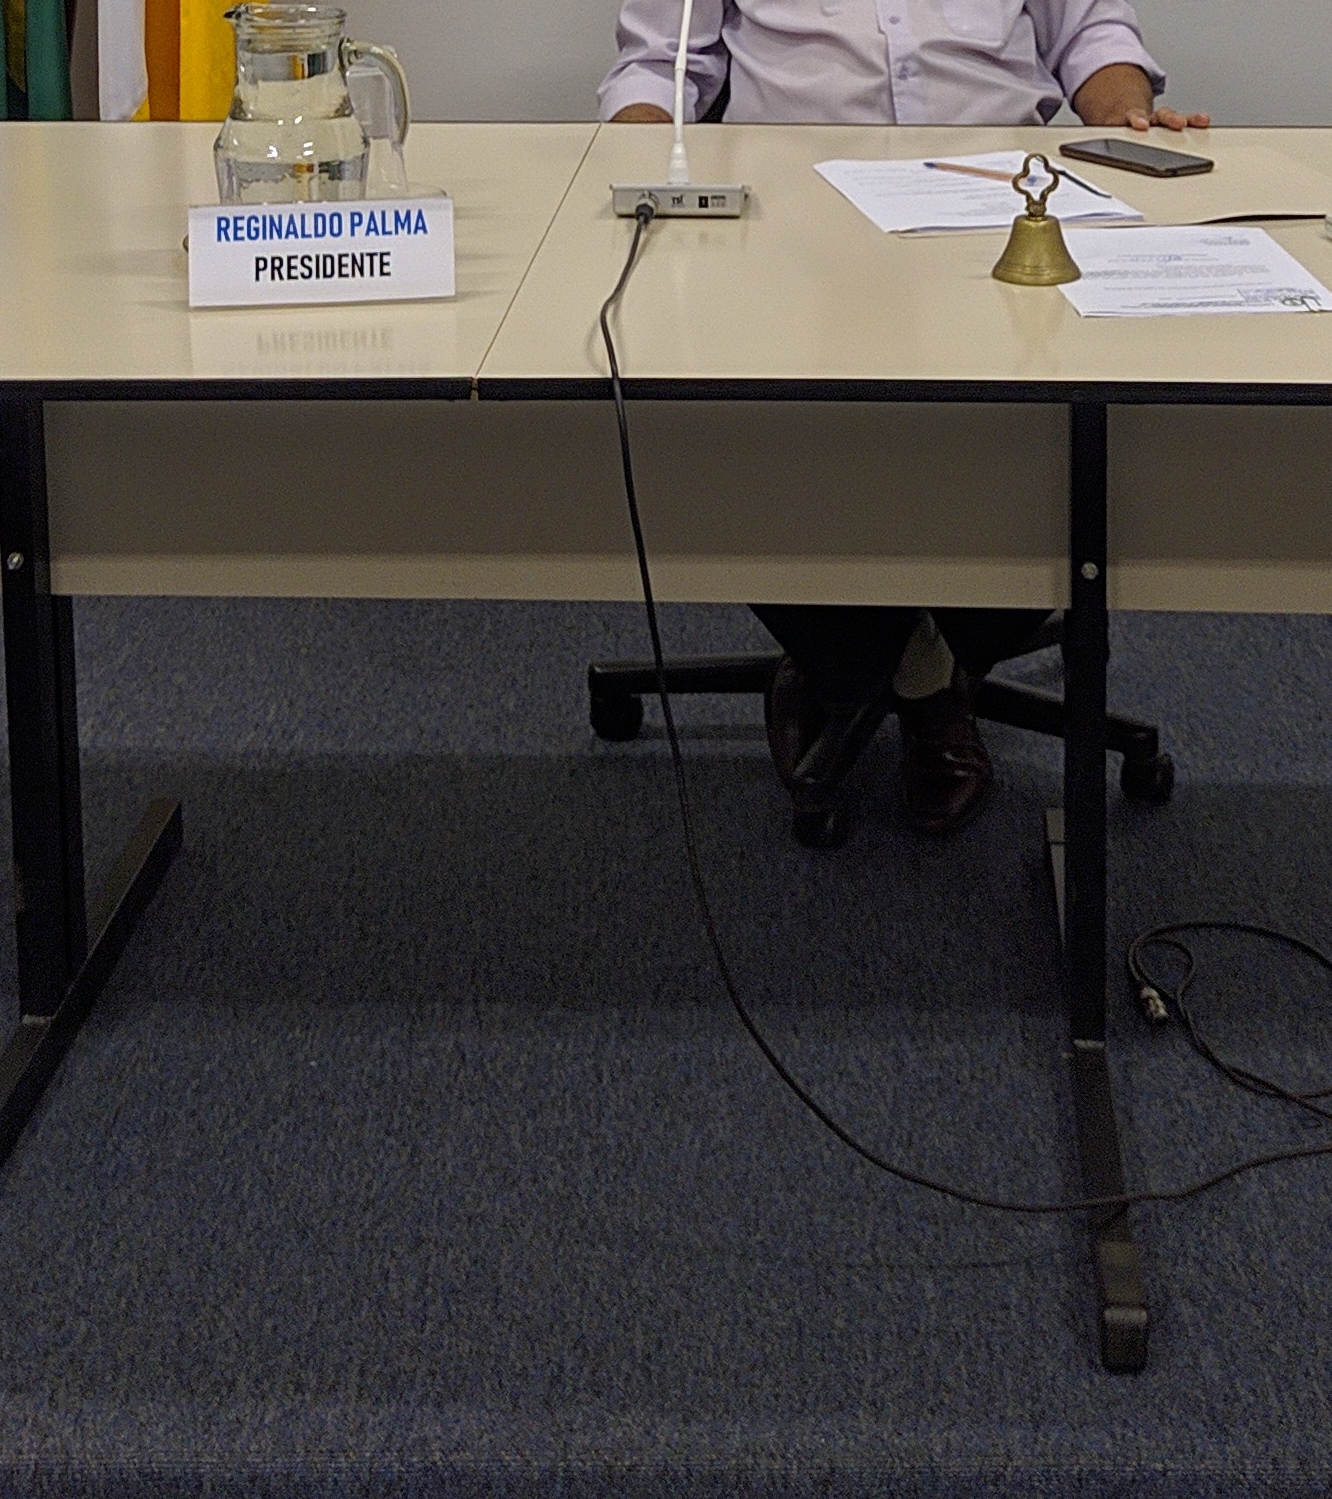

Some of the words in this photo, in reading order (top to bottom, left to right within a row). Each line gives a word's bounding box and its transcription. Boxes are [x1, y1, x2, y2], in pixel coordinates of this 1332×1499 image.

[216, 212, 344, 243] REGINALDO
[350, 208, 429, 237] PALMA
[254, 251, 392, 282] PRESIDENTE
